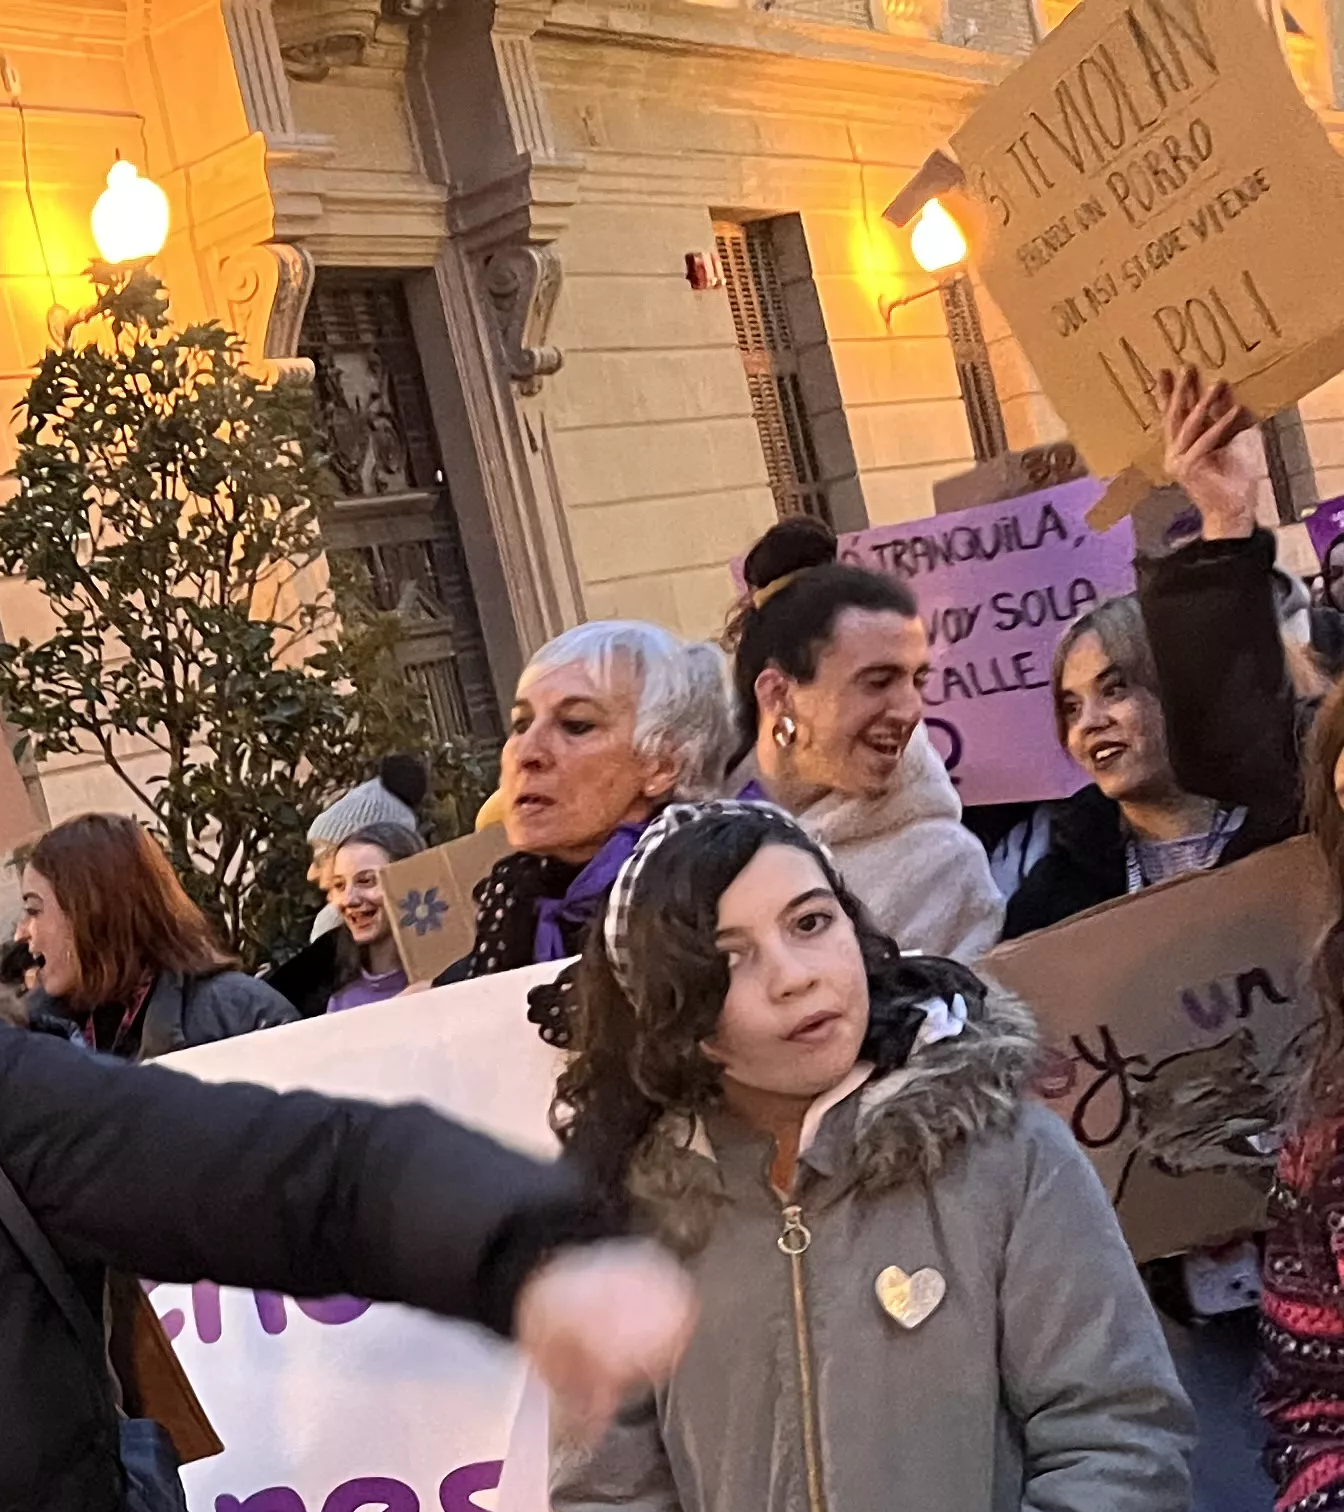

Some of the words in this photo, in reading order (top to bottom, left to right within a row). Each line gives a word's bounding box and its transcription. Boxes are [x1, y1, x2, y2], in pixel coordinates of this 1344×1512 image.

[1028, 0, 1221, 174] VIOLAN
[1006, 131, 1055, 199] TE
[1105, 116, 1213, 225] PORRO
[1144, 226, 1191, 271] QUE
[1187, 166, 1272, 244] VIENE
[1097, 336, 1160, 432] LA
[1152, 269, 1283, 370] POLI
[993, 576, 1098, 632] SOLA
[923, 651, 1051, 706] CALLE
